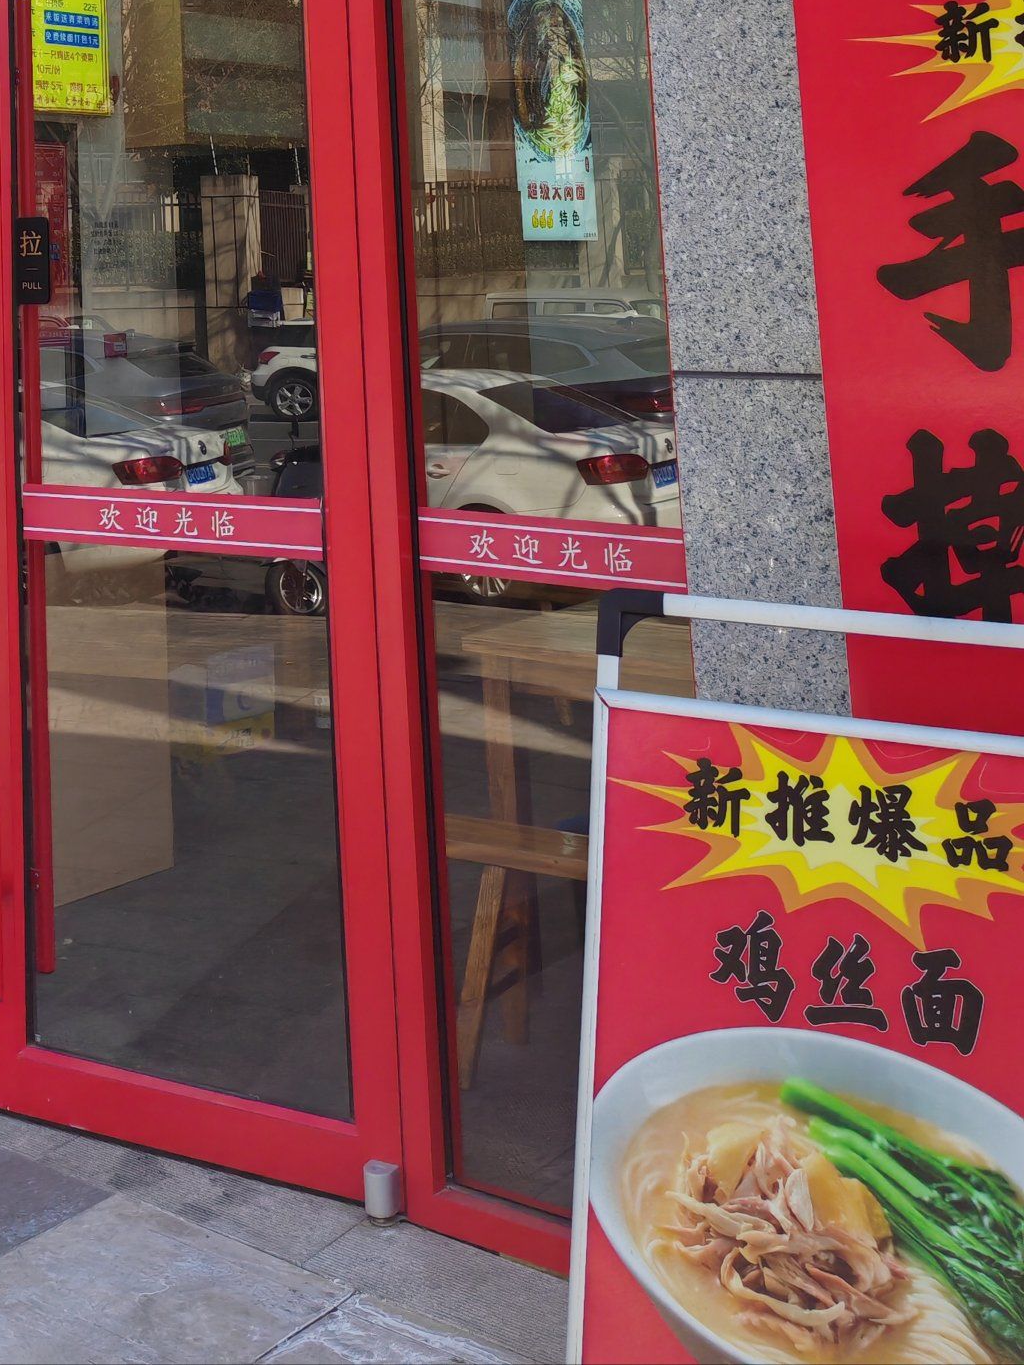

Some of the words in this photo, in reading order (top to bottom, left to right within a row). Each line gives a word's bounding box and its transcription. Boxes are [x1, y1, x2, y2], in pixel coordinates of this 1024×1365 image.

[83, 3, 98, 13] 22元
[933, 0, 1024, 65] 新
[527, 179, 586, 202] 超级大肉面
[559, 209, 581, 227] 特色
[20, 230, 42, 257] 拉
[22, 282, 42, 290] PULL
[97, 503, 236, 537] 欢迎光临
[468, 529, 633, 575] 欢迎光临
[682, 757, 1012, 872] 新推爆品
[709, 909, 985, 1057] 鸡丝面
